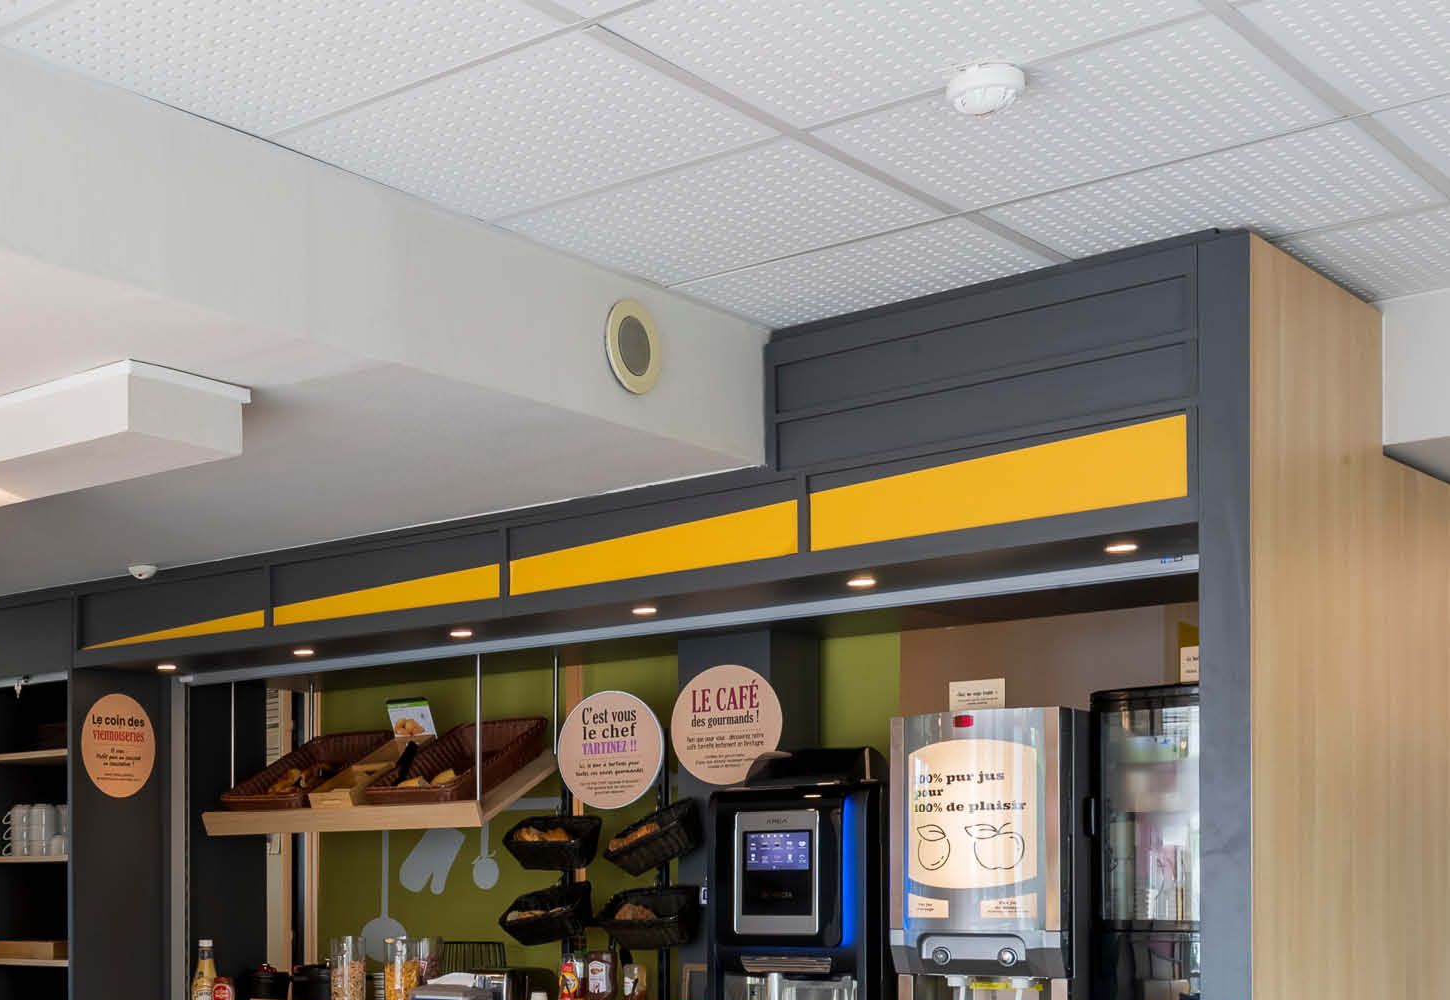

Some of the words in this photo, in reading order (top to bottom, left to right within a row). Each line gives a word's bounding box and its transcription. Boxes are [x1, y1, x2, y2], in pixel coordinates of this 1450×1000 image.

[691, 689, 711, 713] LE
[716, 679, 759, 711] CAFÉ
[92, 714, 102, 725] Le
[105, 714, 125, 726] coin
[127, 716, 145, 727] des
[582, 707, 608, 725] C'est
[612, 709, 637, 722] vous
[691, 714, 706, 728] des
[708, 711, 754, 728] gourmands
[583, 726, 596, 740] le
[602, 722, 637, 738] chef
[582, 740, 627, 755] TARTINEZ
[946, 773, 974, 785] pur
[977, 771, 1005, 784] jus
[946, 802, 965, 812] de
[969, 800, 1027, 814] plaisir
